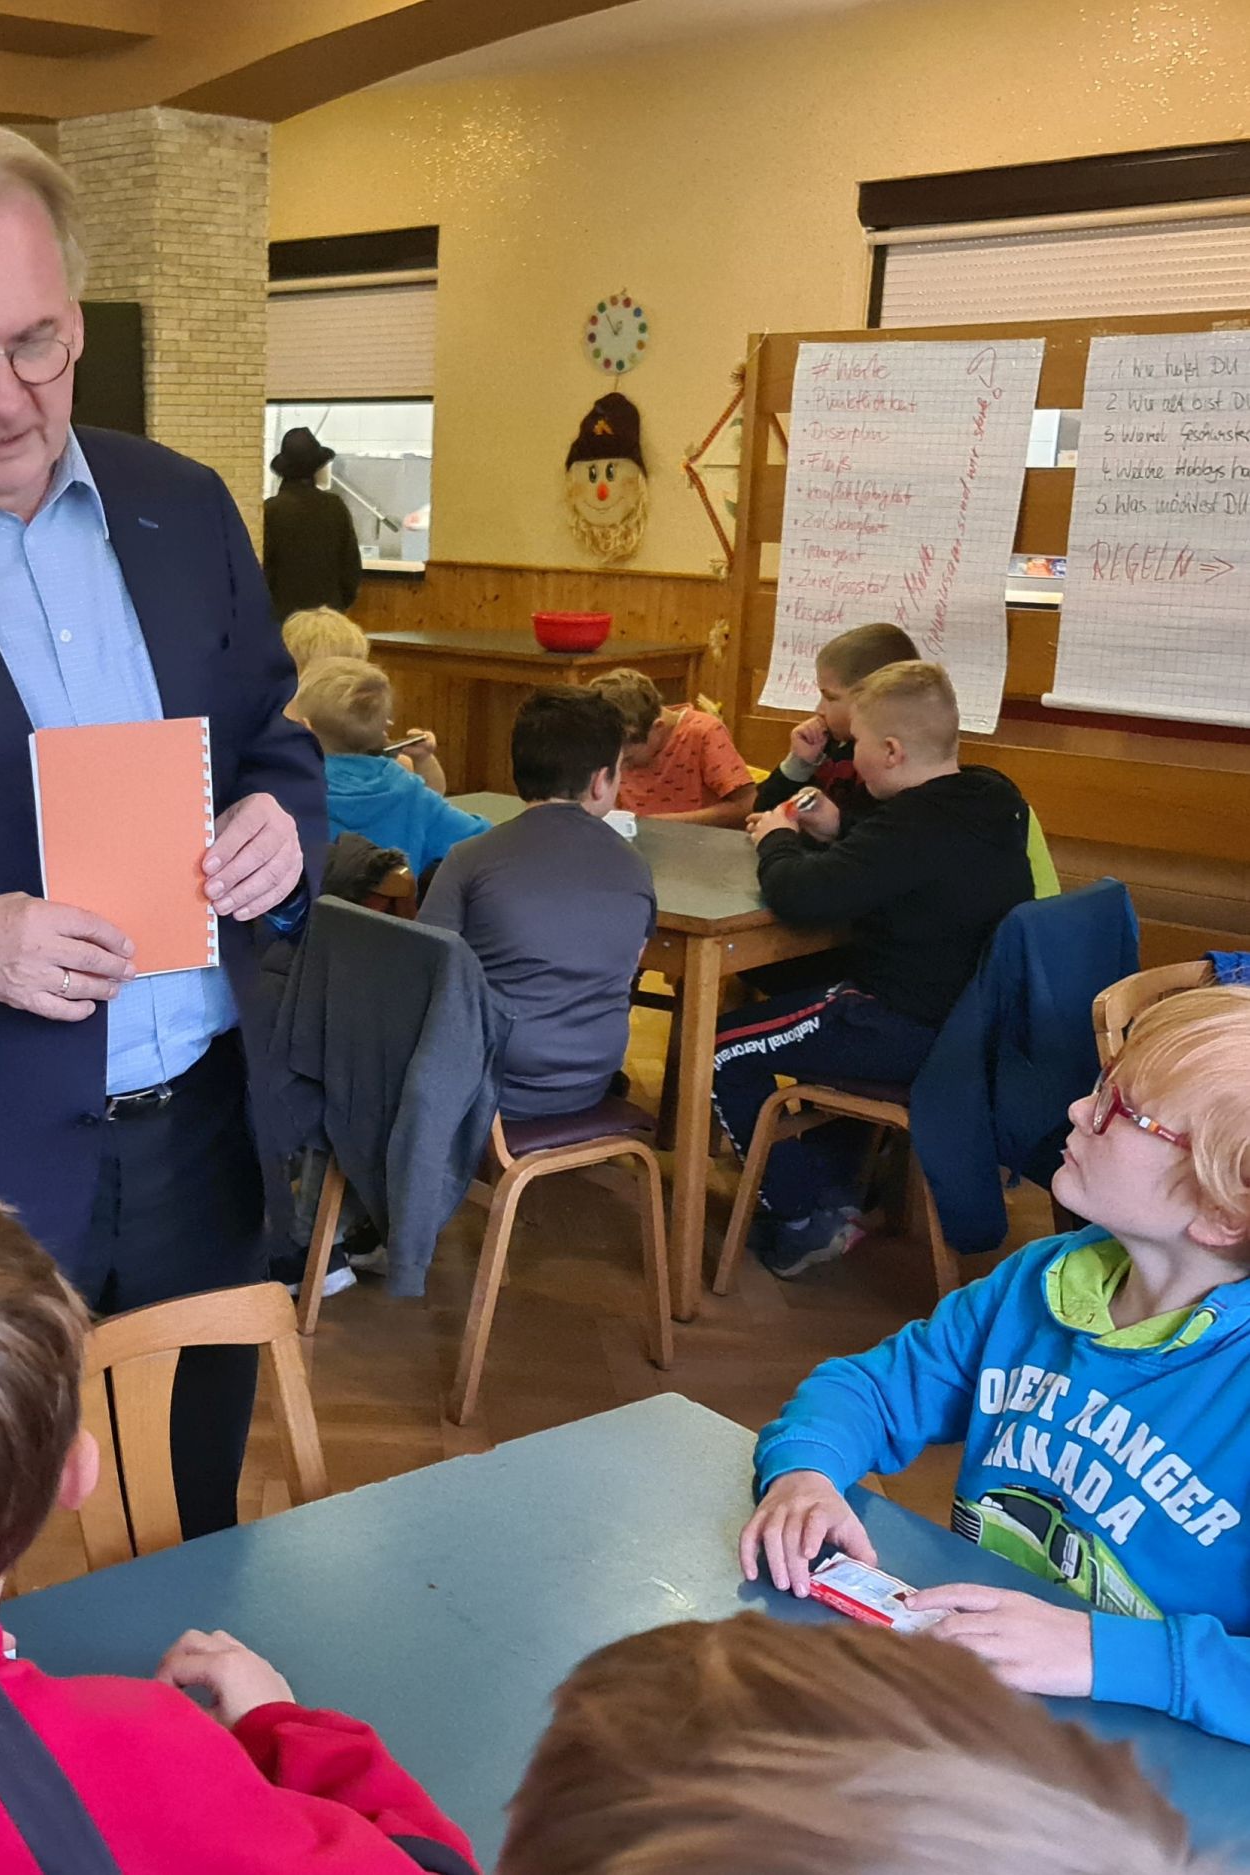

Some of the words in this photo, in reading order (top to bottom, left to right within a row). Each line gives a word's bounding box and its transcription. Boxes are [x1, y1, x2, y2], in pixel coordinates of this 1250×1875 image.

[1206, 355, 1238, 375] DU
[1115, 494, 1147, 514] Was
[1088, 538, 1195, 585] REGELN
[768, 1016, 820, 1052] National
[1065, 1388, 1241, 1547] RANGER
